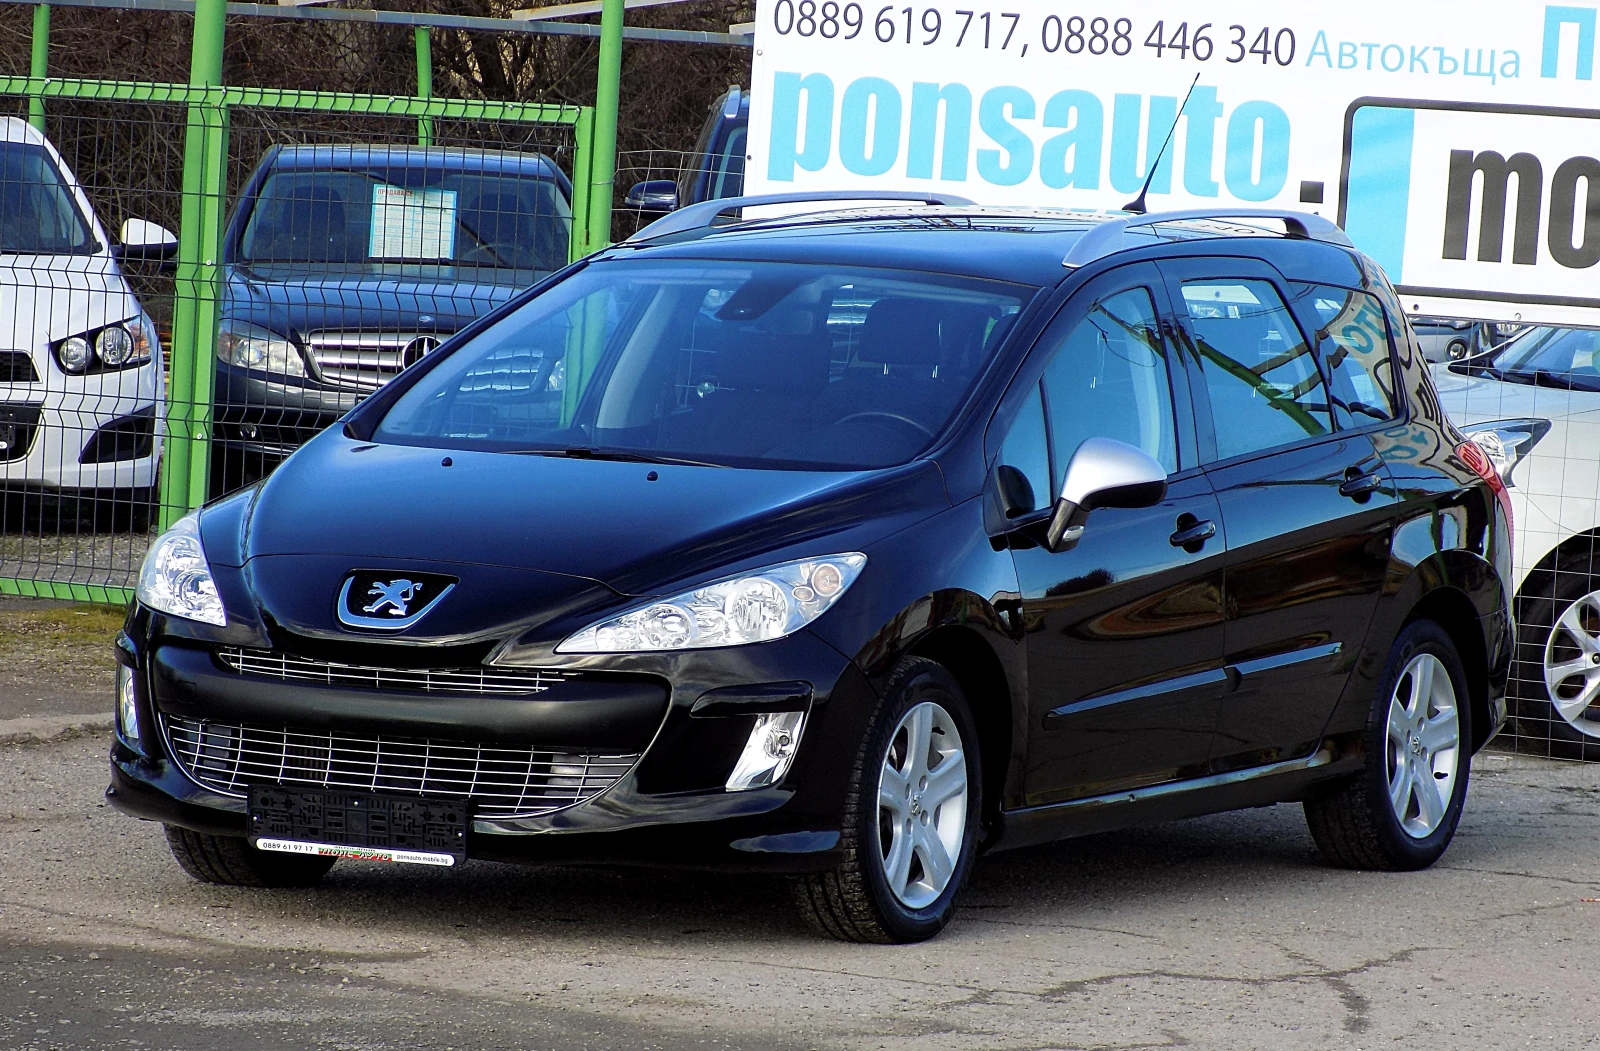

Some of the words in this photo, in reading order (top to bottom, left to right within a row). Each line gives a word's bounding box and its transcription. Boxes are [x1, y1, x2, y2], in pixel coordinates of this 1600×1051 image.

[774, 0, 863, 40] 0889
[875, 5, 942, 46] 619
[955, 10, 1029, 57] 717,
[1041, 14, 1132, 56] 0888
[1143, 20, 1214, 62] 446
[1226, 24, 1296, 67] 340
[1305, 29, 1521, 86] Автокъща
